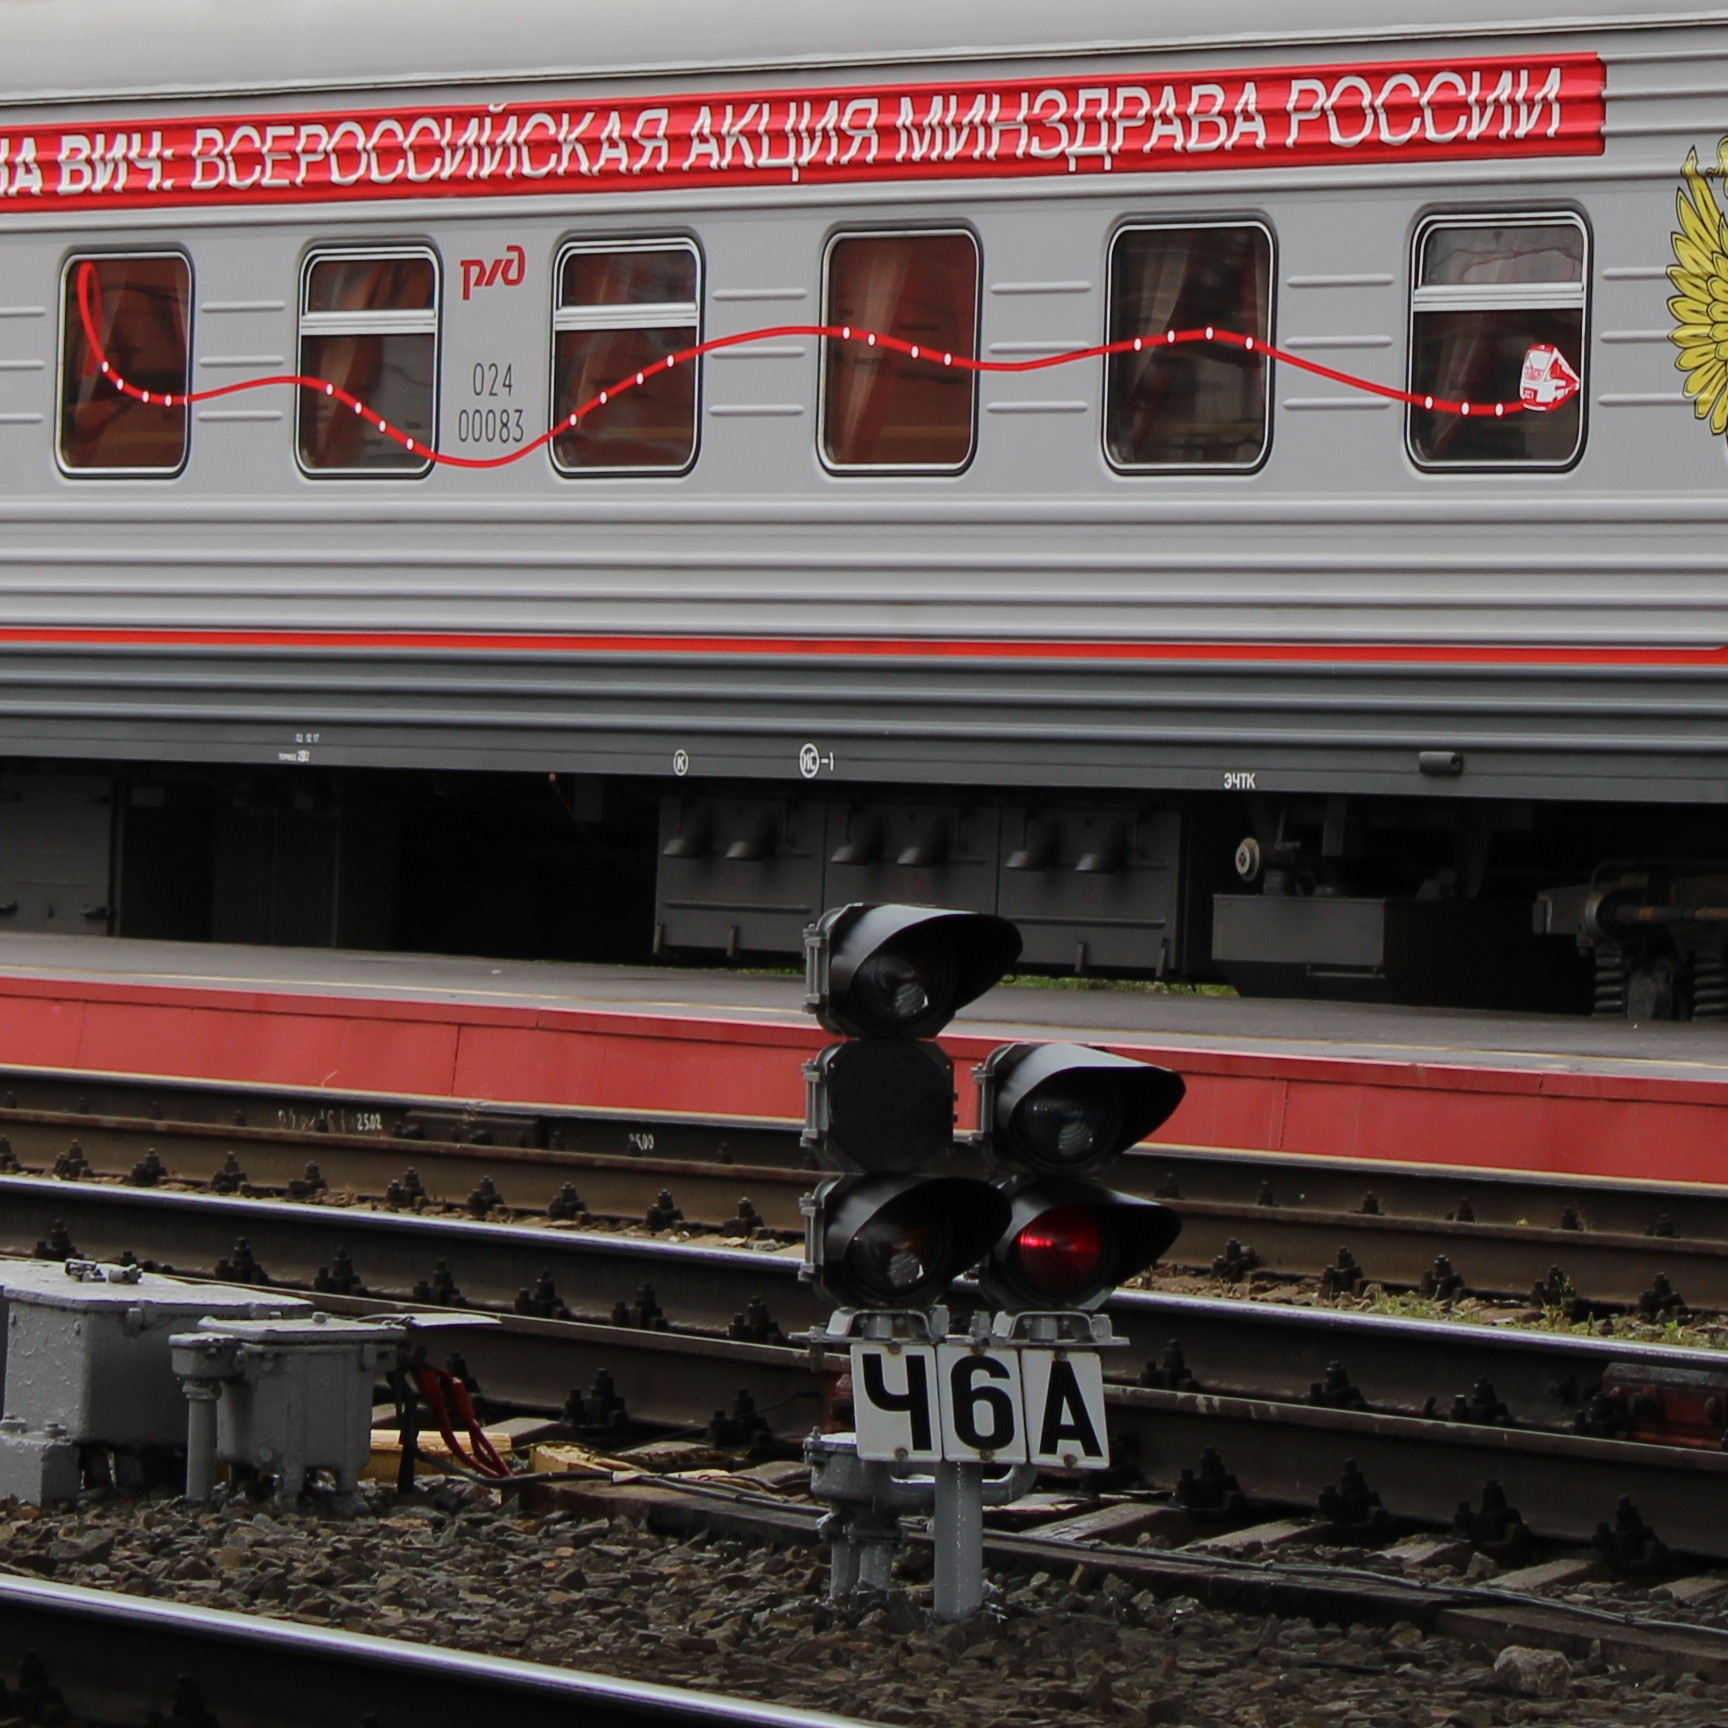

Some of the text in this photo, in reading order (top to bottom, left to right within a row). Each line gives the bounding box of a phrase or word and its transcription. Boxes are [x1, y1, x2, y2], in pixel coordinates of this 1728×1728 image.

[57, 131, 176, 194] ВИЧ:
[191, 102, 670, 190] ВСЕРОССИЙСКАЯ
[682, 97, 880, 182] АКЦИЯ
[895, 81, 1265, 171] МИНЗДРАВА
[1285, 68, 1562, 148] РОССИИ
[473, 363, 513, 397] 024
[458, 409, 524, 444] 00083
